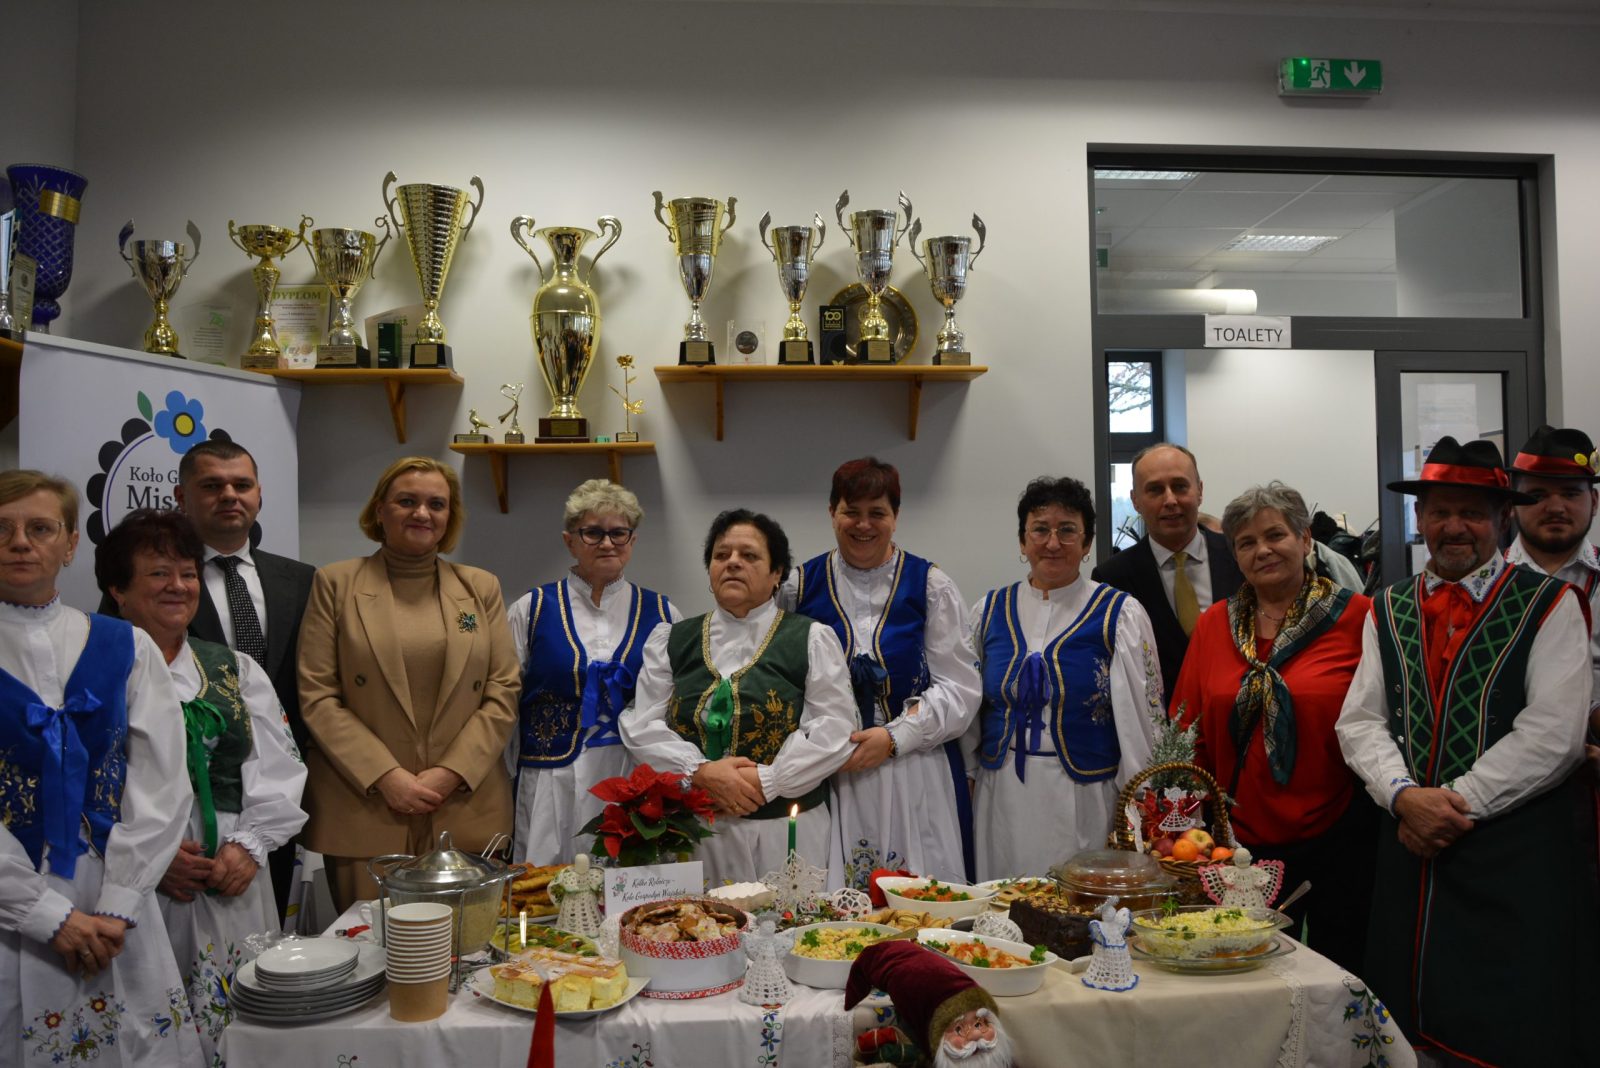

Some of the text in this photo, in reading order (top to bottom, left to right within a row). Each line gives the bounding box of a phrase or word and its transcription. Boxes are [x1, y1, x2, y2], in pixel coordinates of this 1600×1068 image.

[272, 291, 321, 300] DYPLOM
[824, 310, 842, 321] 100
[1213, 327, 1283, 342] TOALETY
[129, 466, 164, 483] Koło
